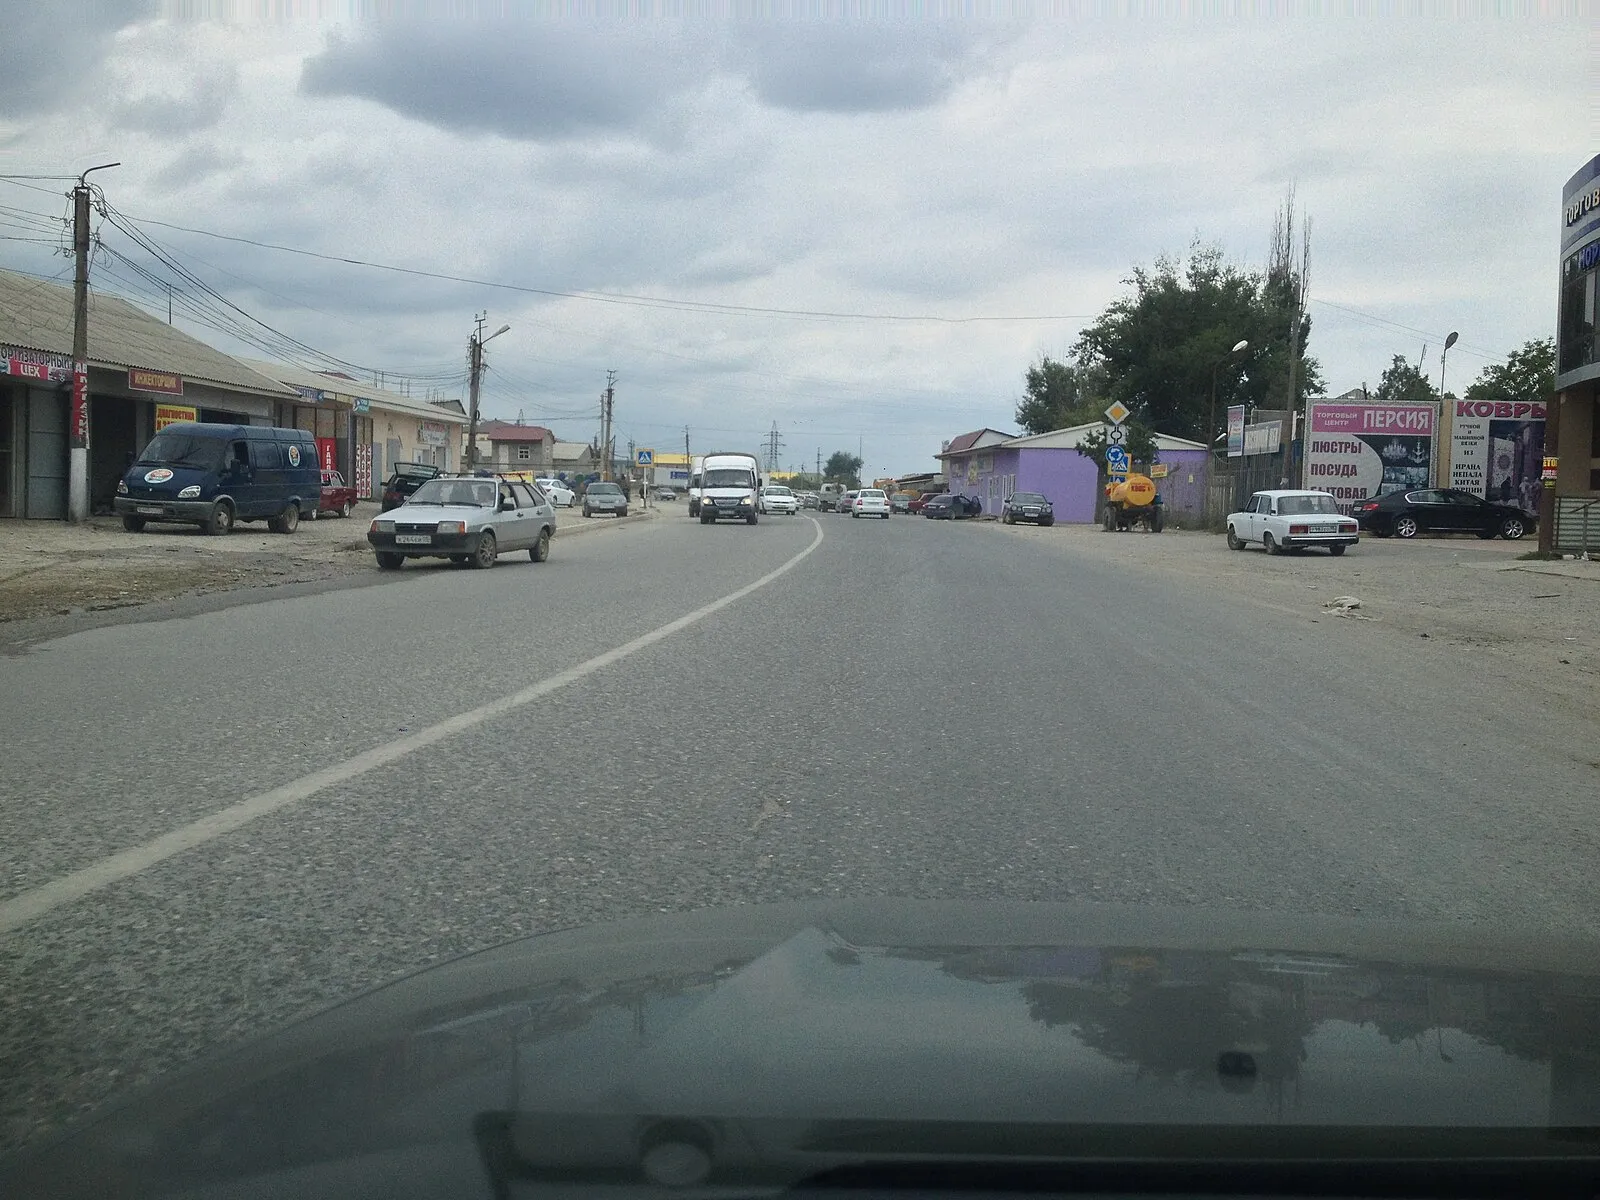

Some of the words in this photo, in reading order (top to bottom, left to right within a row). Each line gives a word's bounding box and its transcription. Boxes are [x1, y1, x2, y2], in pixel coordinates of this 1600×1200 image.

[1578, 243, 1600, 269] НОР
[20, 364, 40, 378] ЦЕХ
[1363, 410, 1429, 430] ПЕРСИЯ
[1311, 441, 1362, 454] ЛЮСТРЫ
[1310, 464, 1358, 478] ПОСУДА
